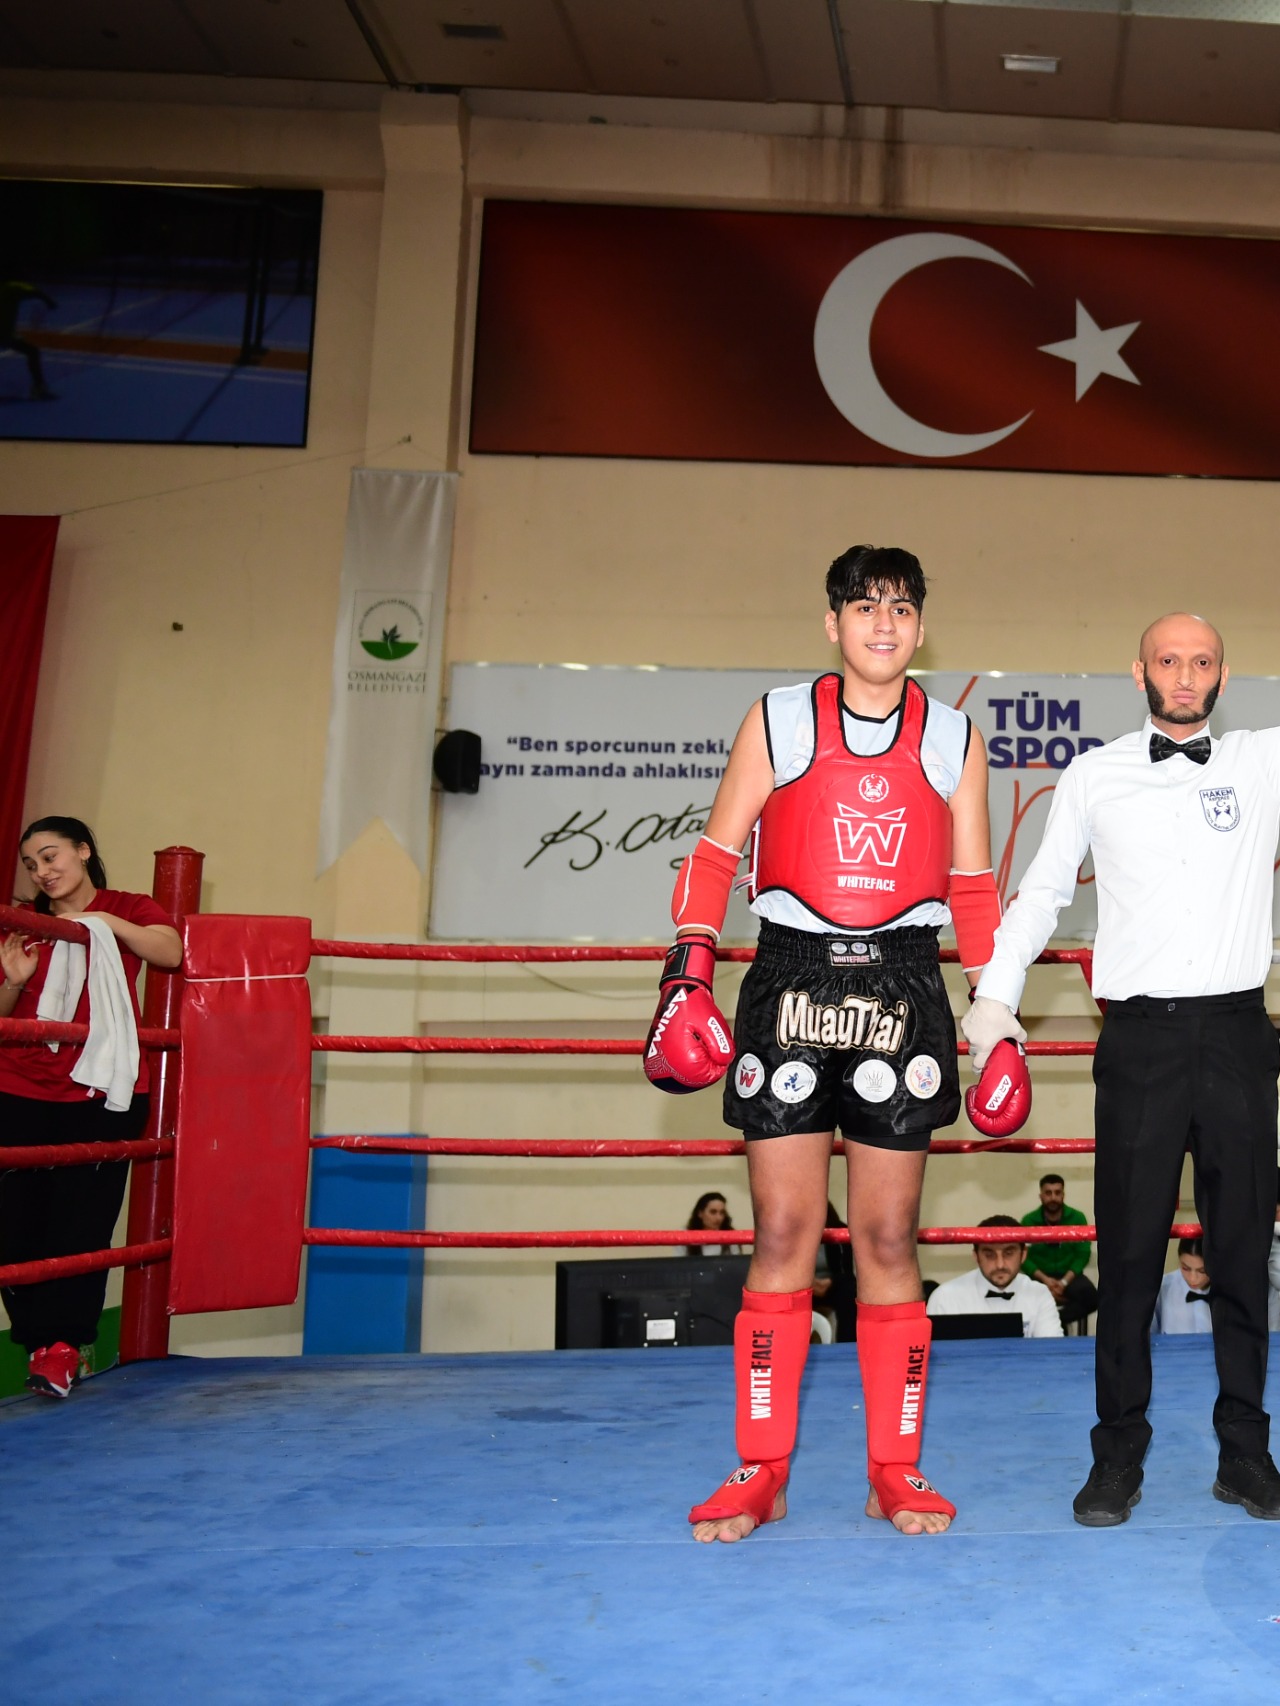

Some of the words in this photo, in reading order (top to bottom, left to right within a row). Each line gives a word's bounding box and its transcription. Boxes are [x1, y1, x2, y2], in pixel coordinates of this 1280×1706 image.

[988, 691, 1080, 731] TÜM
[565, 738, 675, 756] sporcunun
[682, 739, 730, 757] zeki,
[480, 763, 524, 779] aynı
[531, 763, 626, 778] zamanda
[1203, 789, 1233, 799] HAKEM
[837, 875, 896, 892] WHITEFACE
[647, 988, 688, 1058] ARIMA
[751, 1330, 774, 1420] WHITEFACE
[900, 1344, 926, 1435] WHITEFACE
